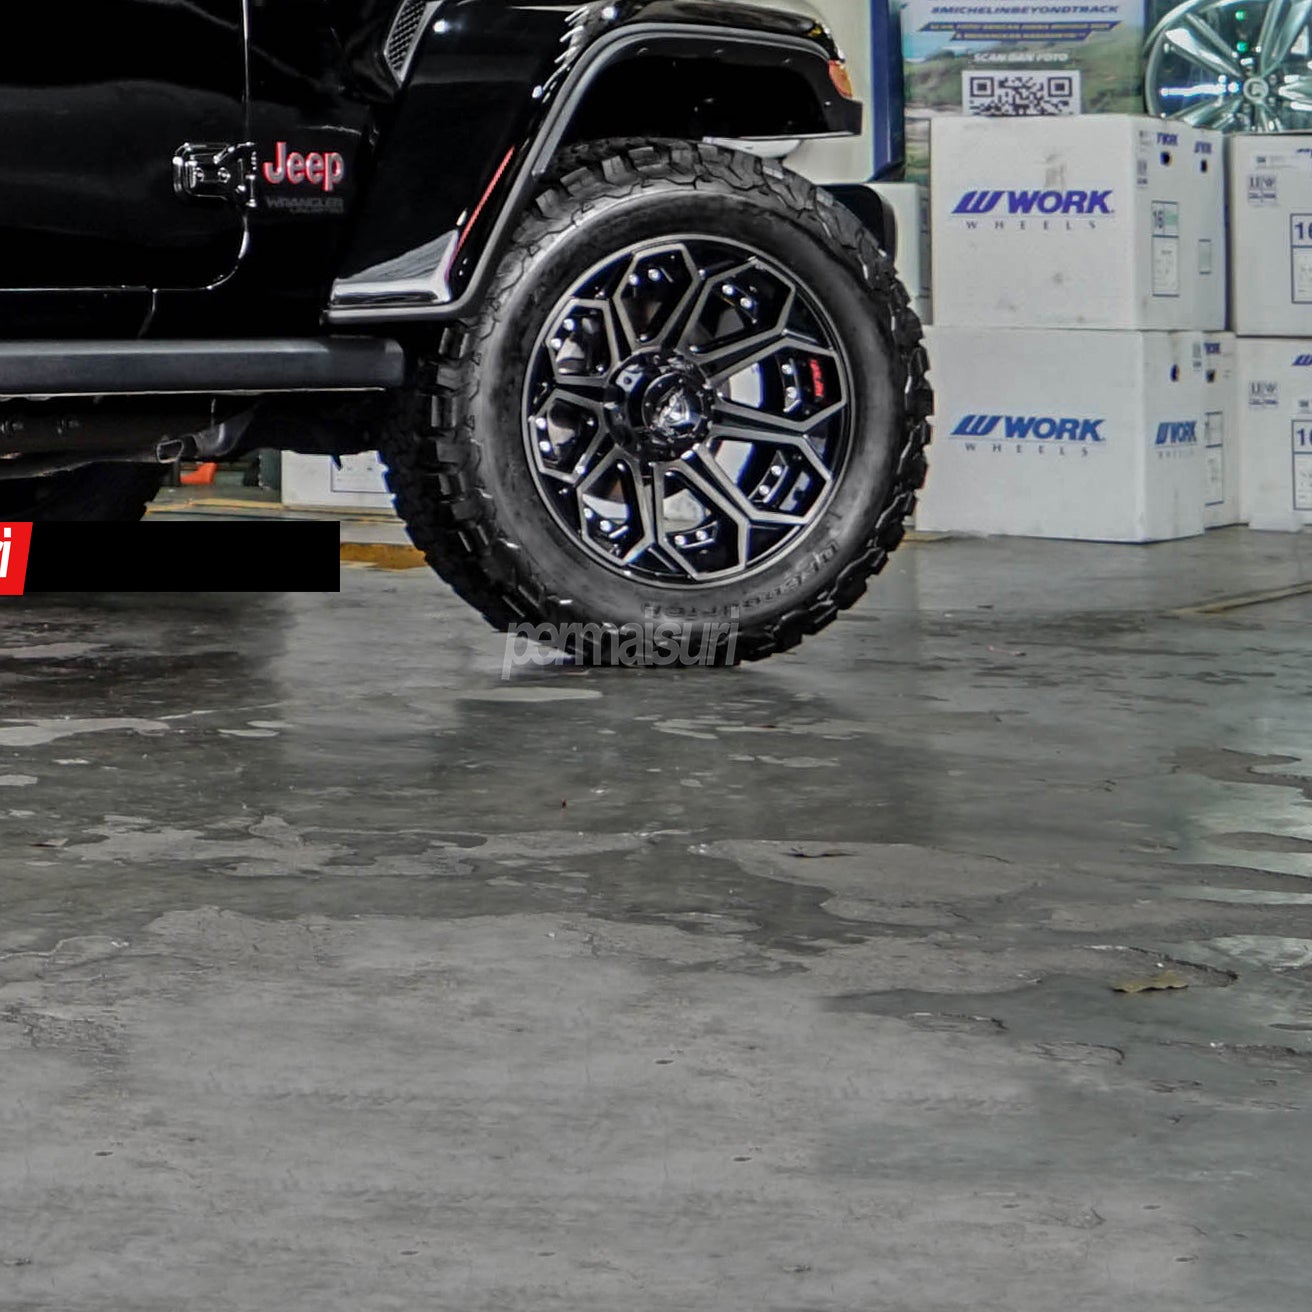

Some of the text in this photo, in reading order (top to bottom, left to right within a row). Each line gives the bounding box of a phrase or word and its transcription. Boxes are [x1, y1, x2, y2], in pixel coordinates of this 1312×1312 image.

[1036, 52, 1069, 62] FOTO
[263, 141, 344, 191] Jeep
[966, 220, 1096, 229] WHEELS
[966, 443, 1089, 457] WHEELS
